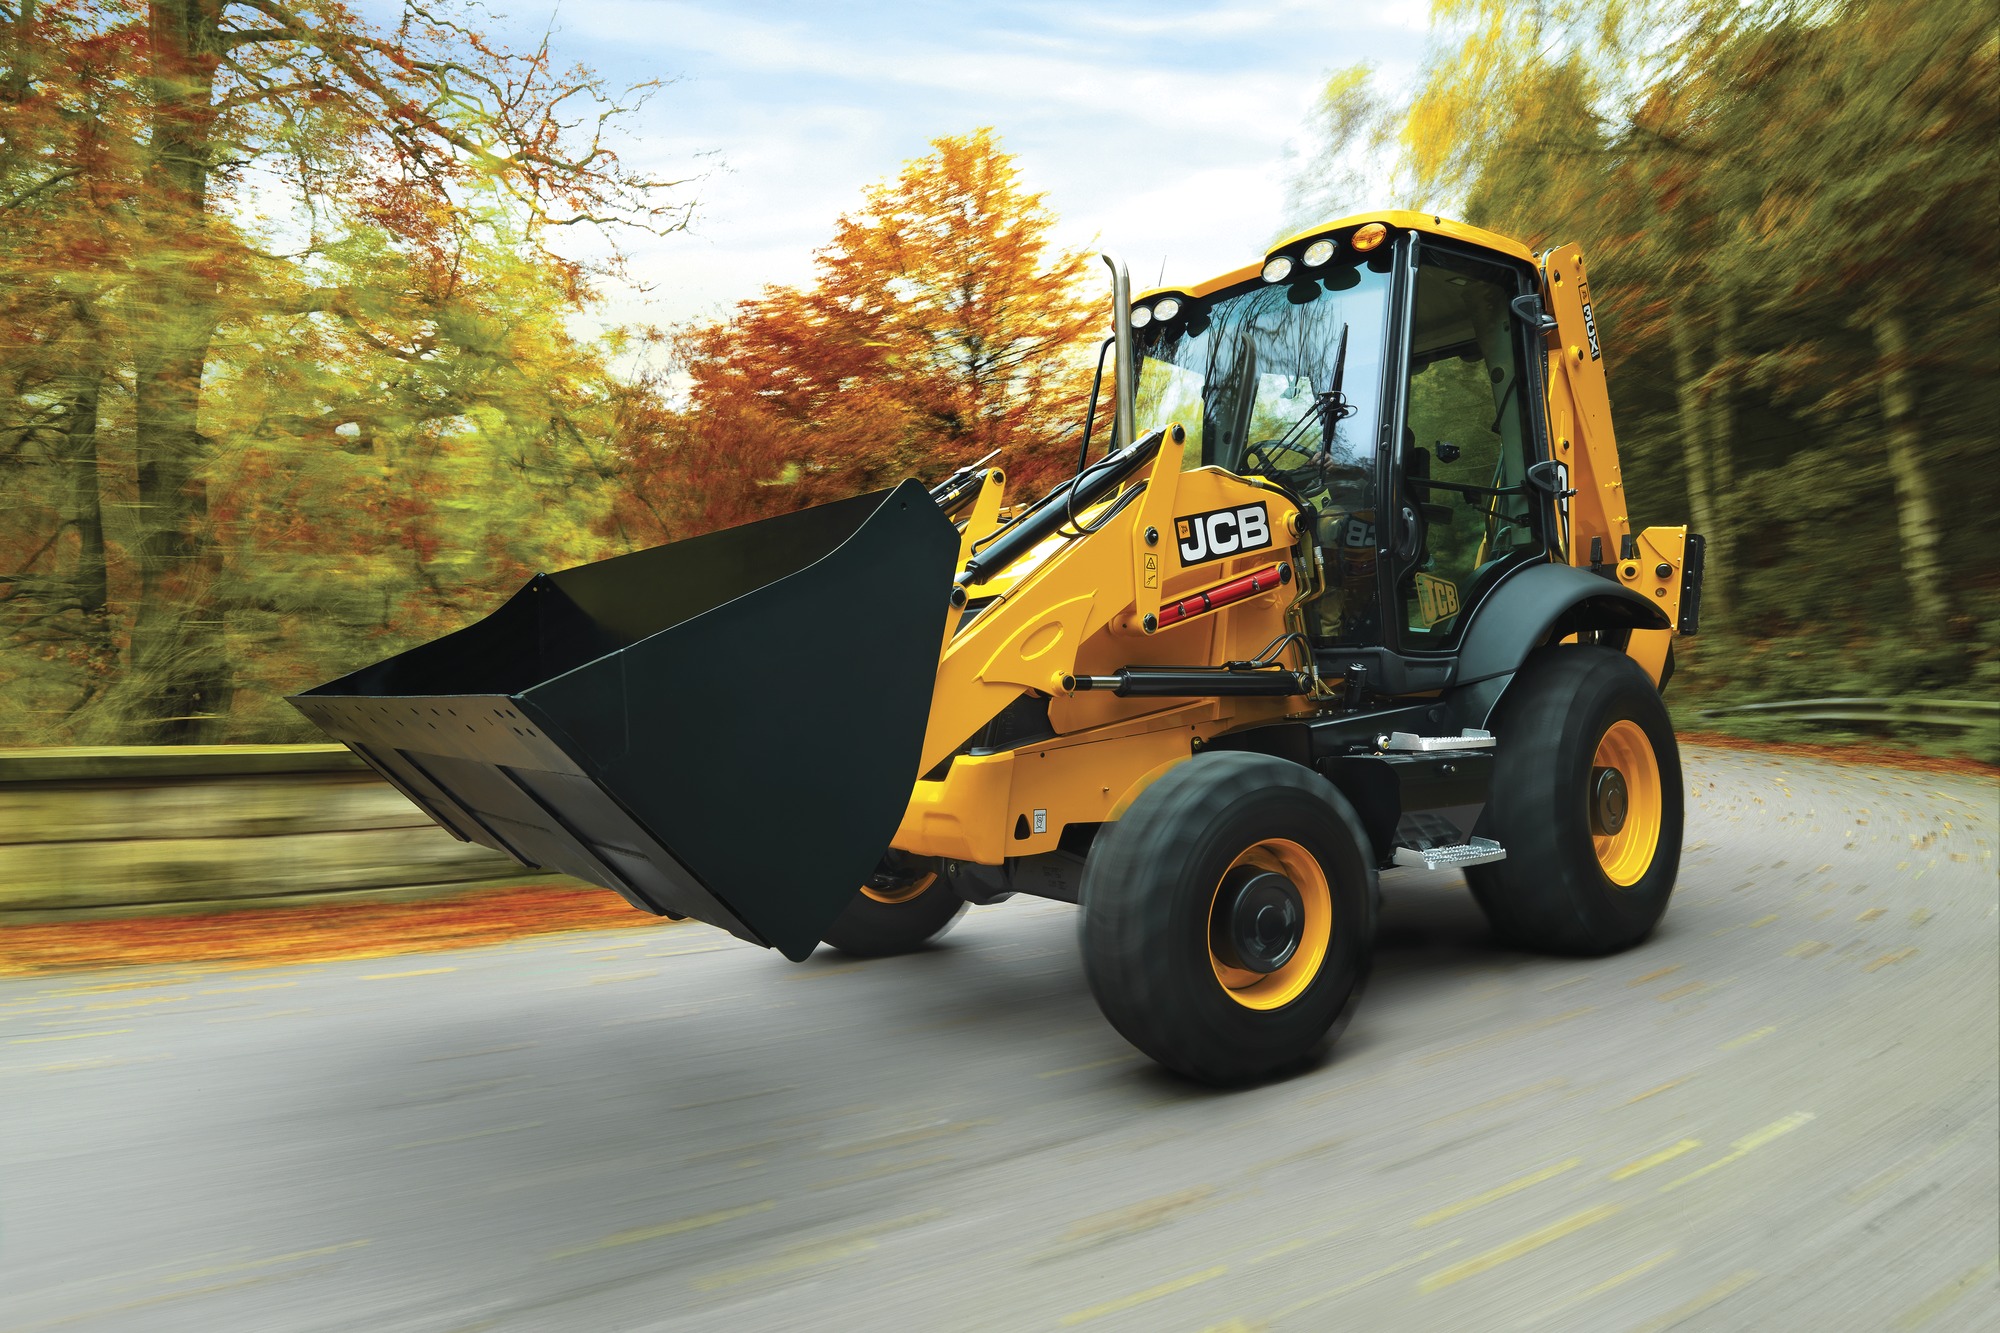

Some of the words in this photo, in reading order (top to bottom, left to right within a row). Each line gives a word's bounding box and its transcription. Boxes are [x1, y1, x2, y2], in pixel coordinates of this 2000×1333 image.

[1583, 305, 1599, 352] 3CX
[1181, 506, 1269, 562] JCB
[1423, 580, 1457, 620] JCB
